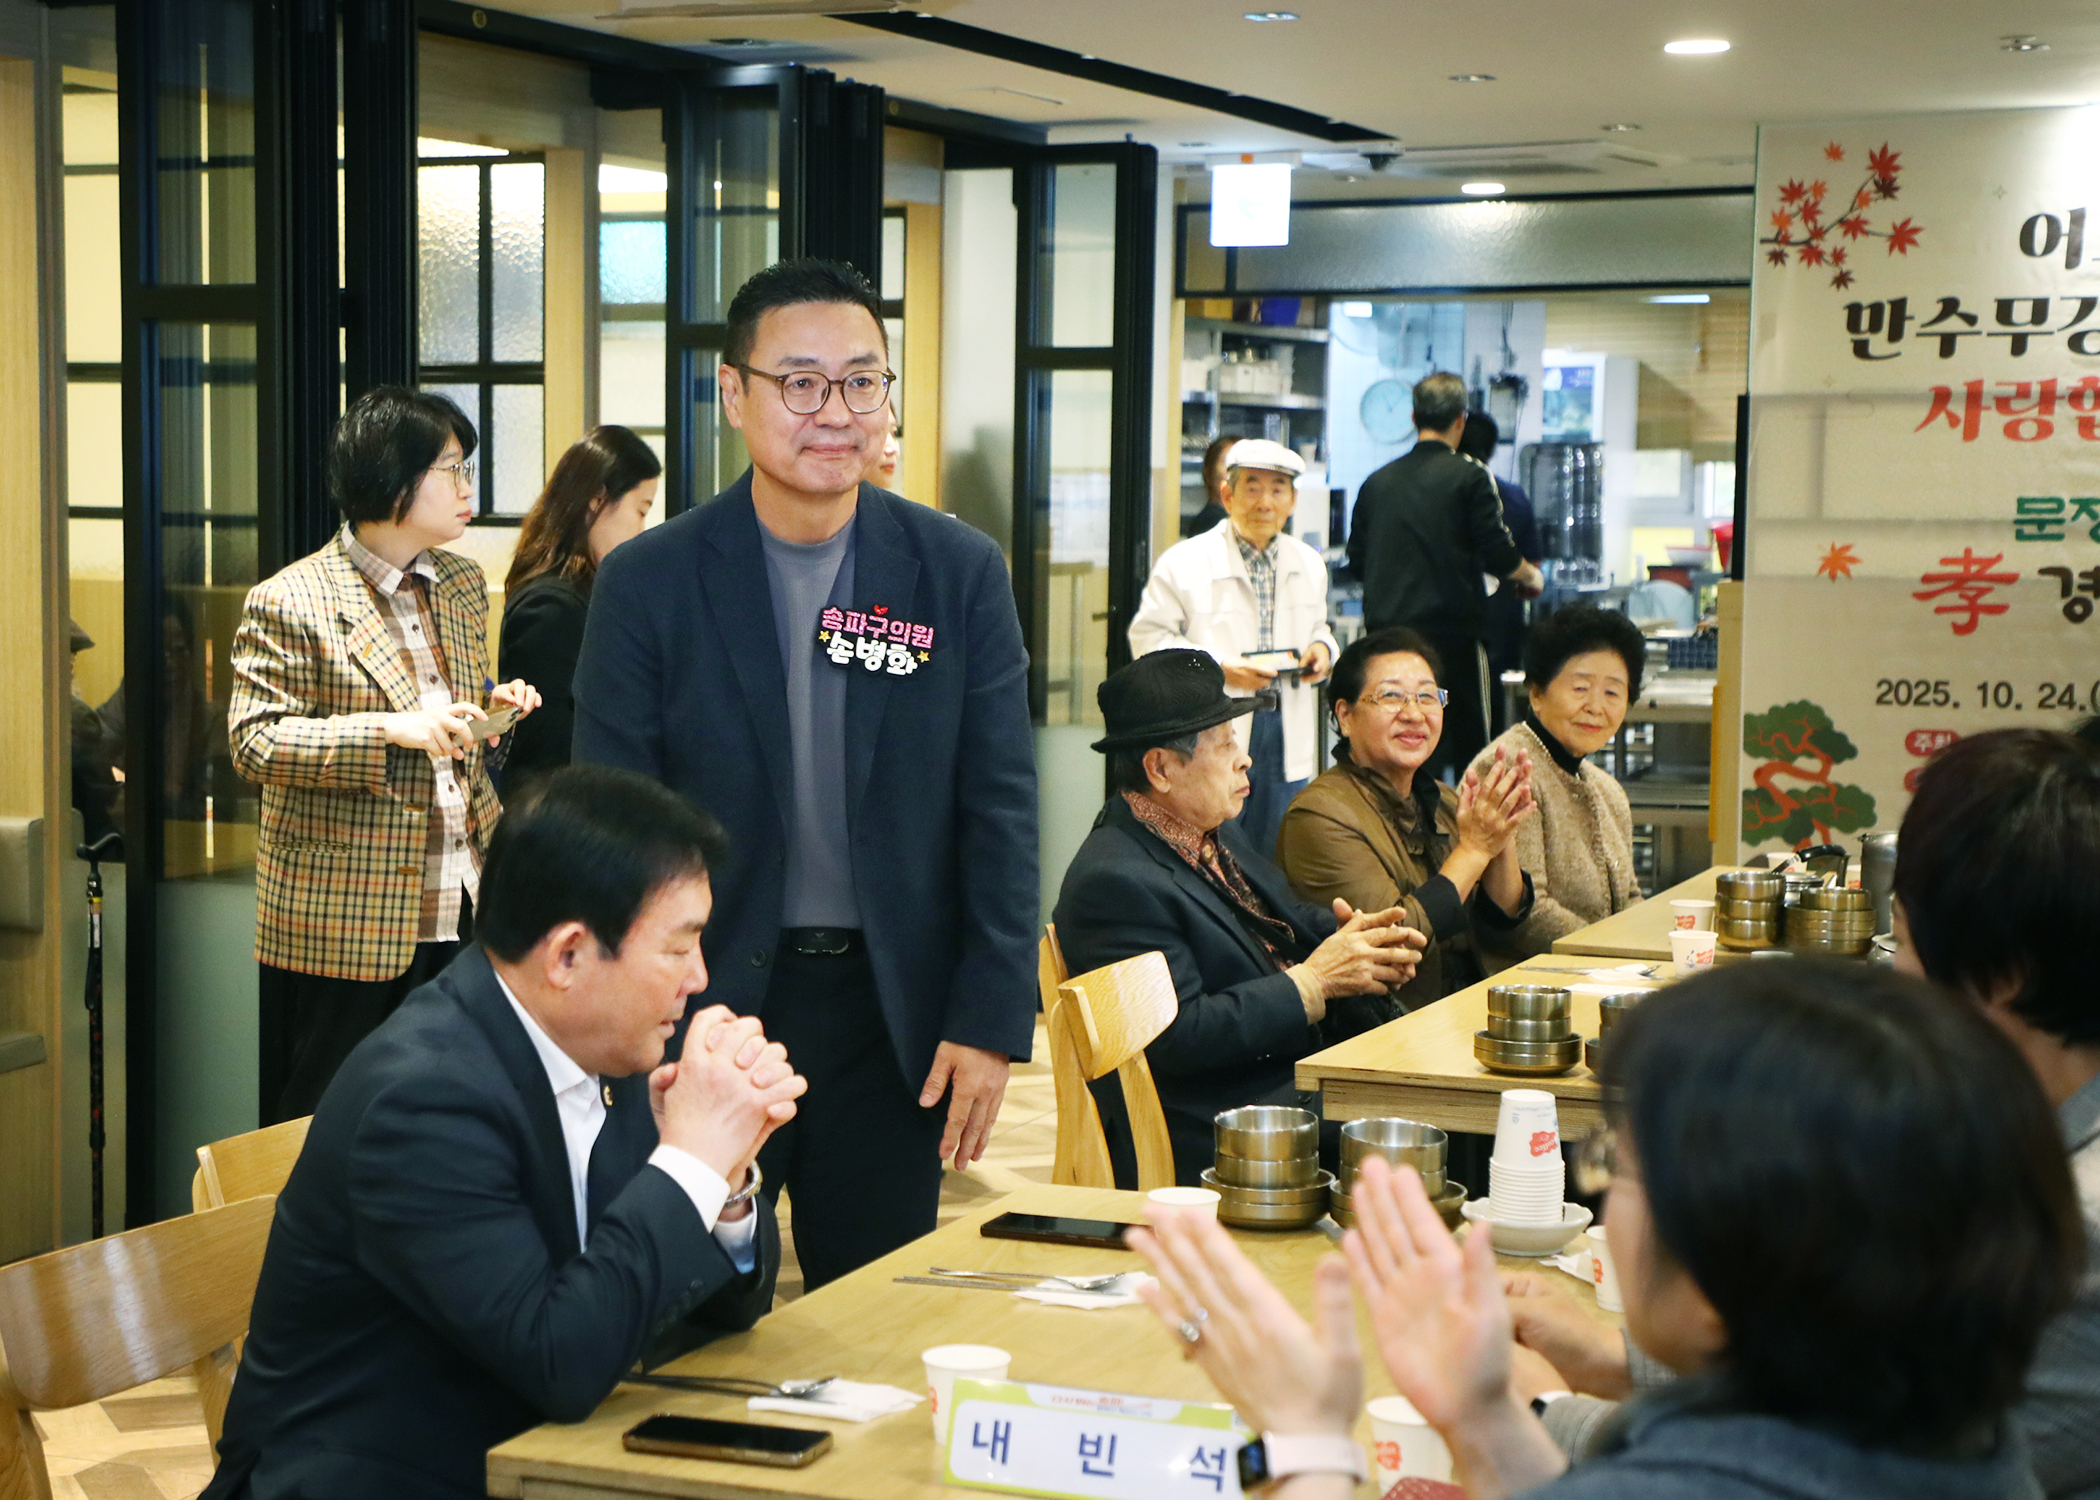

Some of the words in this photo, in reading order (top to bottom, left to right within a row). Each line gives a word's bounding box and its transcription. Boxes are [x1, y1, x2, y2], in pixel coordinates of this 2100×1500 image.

[1912, 546, 2020, 636] 孝
[821, 606, 935, 649] 송파구의원
[826, 631, 919, 676] 손병화
[1875, 678, 1961, 709] 2025.
[1977, 680, 2023, 711] 10.
[972, 1419, 1012, 1466] 내
[1078, 1432, 1118, 1479] 빈
